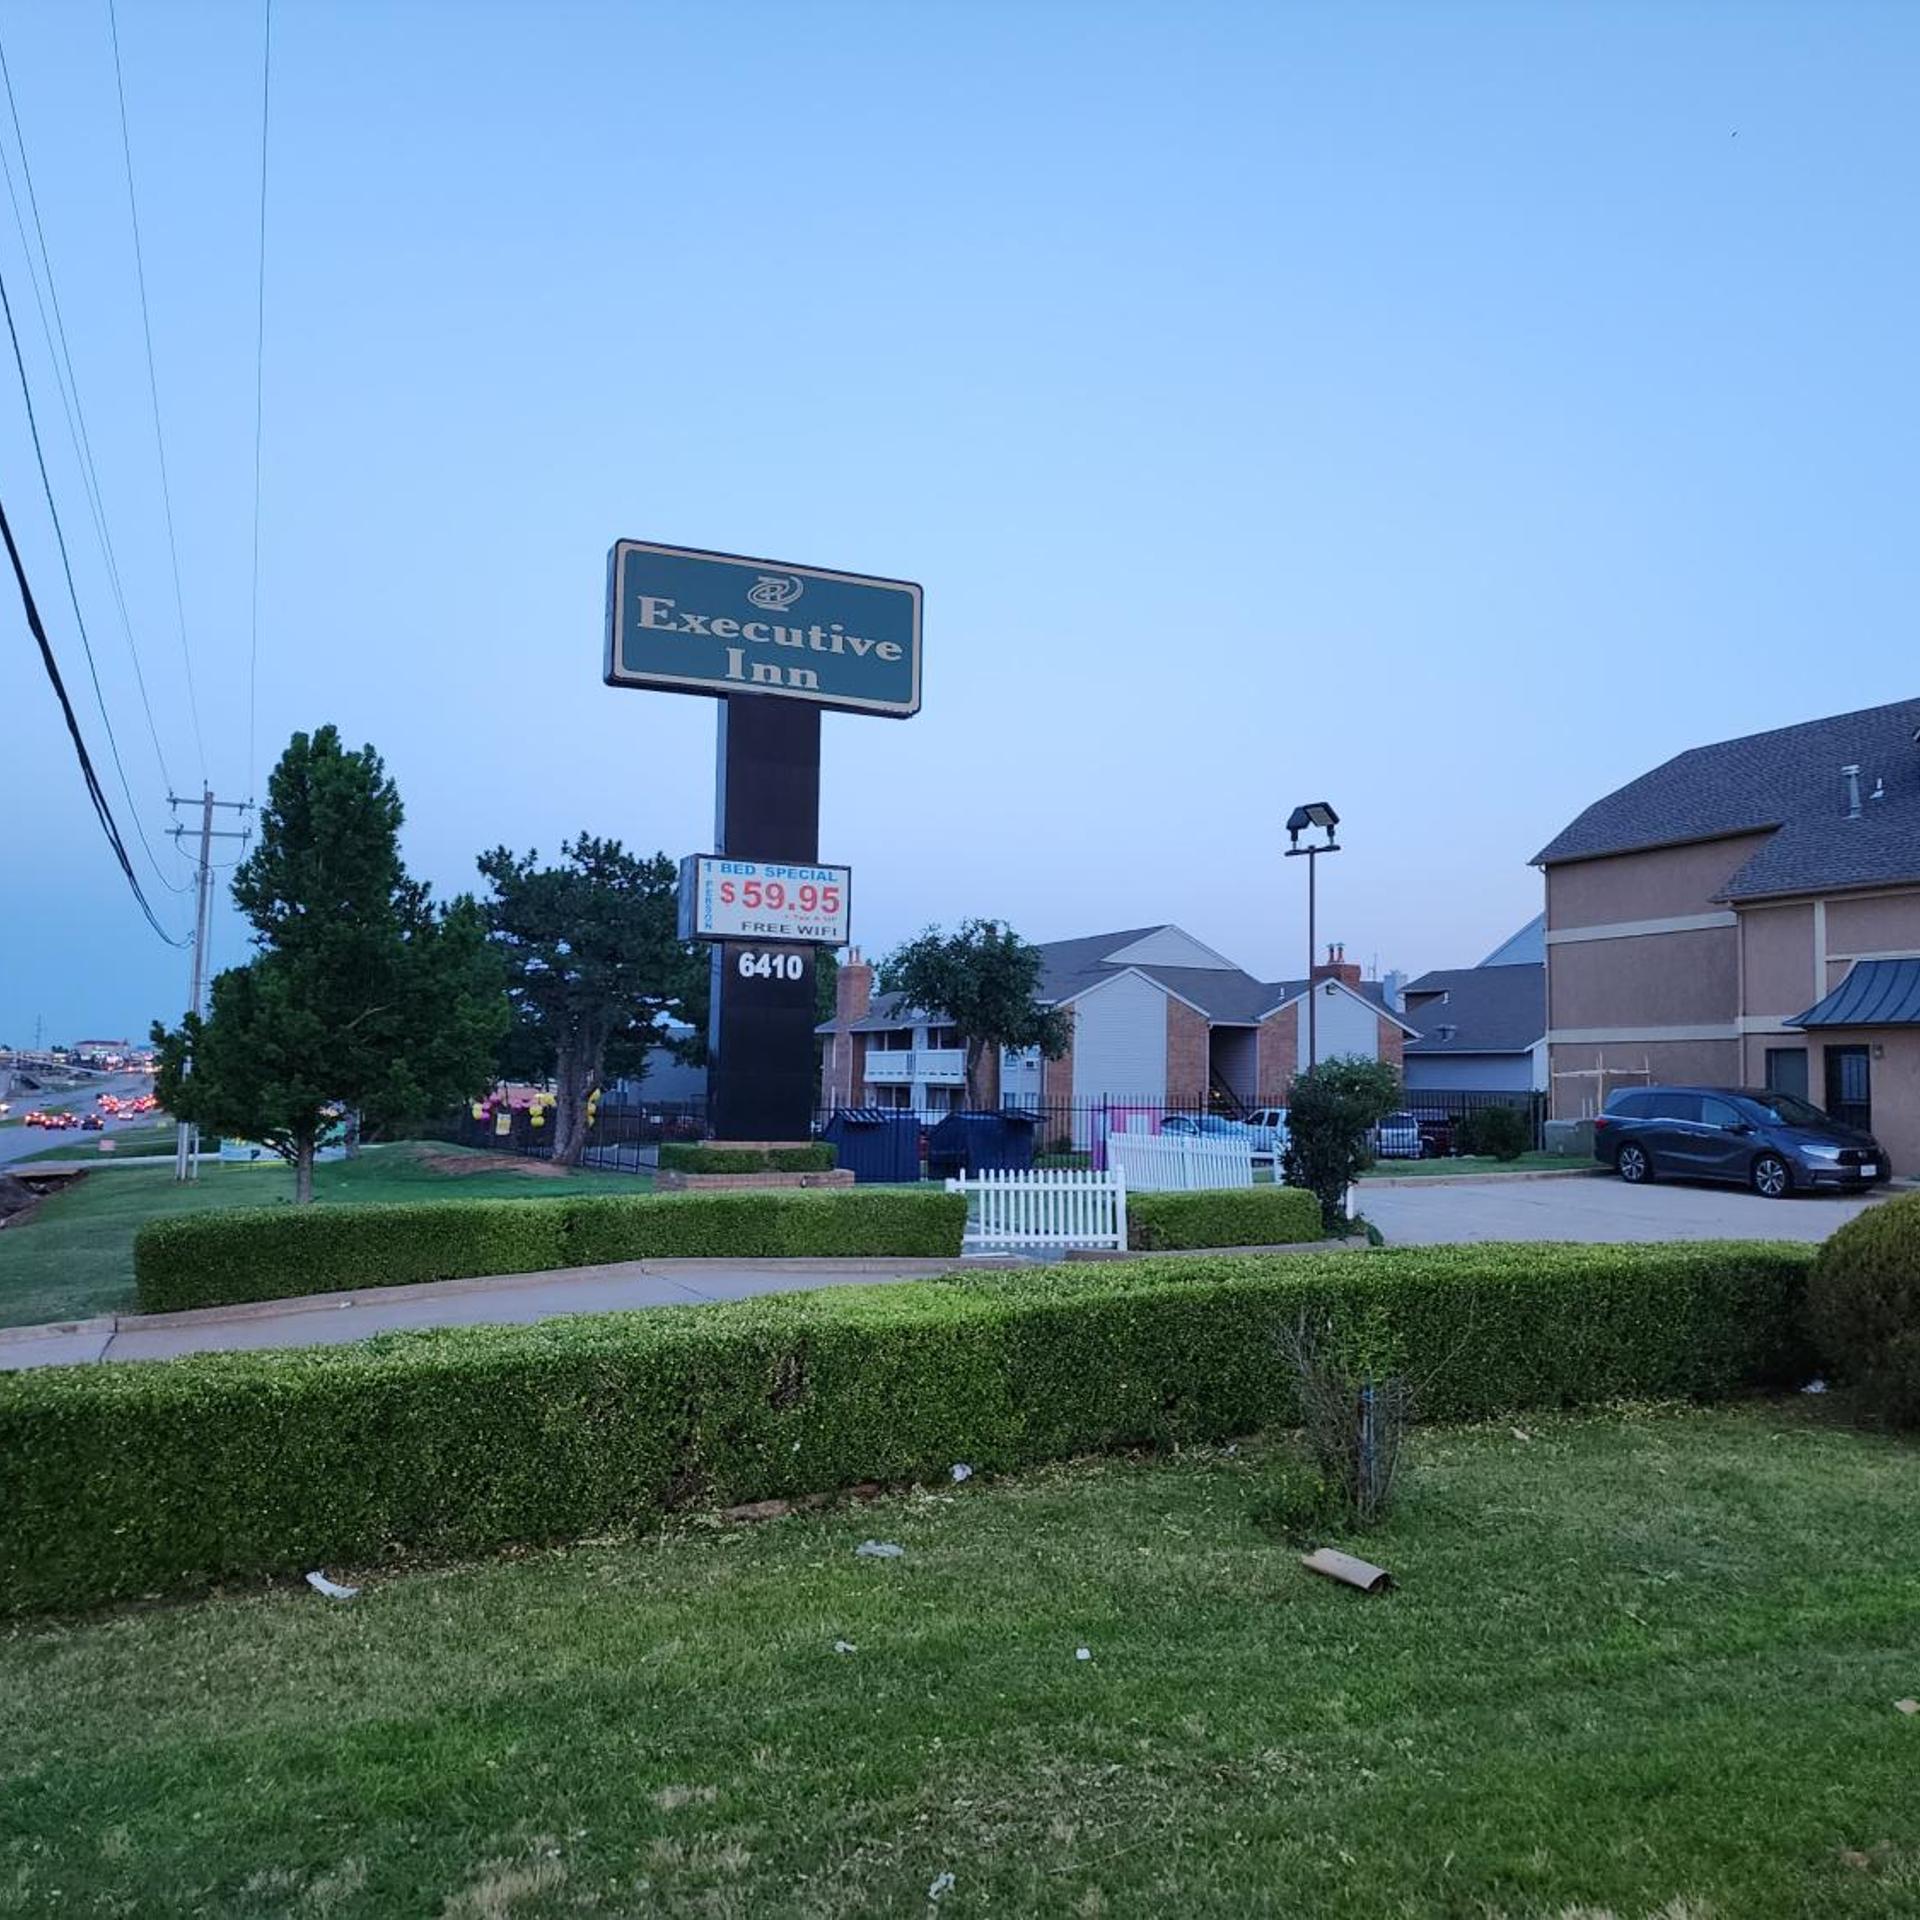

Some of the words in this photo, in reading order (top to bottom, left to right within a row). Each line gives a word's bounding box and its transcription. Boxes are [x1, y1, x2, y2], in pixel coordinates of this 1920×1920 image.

[637, 596, 903, 661] Executive
[725, 648, 819, 689] Inn
[704, 862, 711, 872] 1
[720, 862, 756, 875] BED
[765, 866, 838, 882] SPECIAL
[741, 921, 791, 934] FREE
[797, 925, 837, 936] WIFI
[739, 951, 803, 980] 6410
